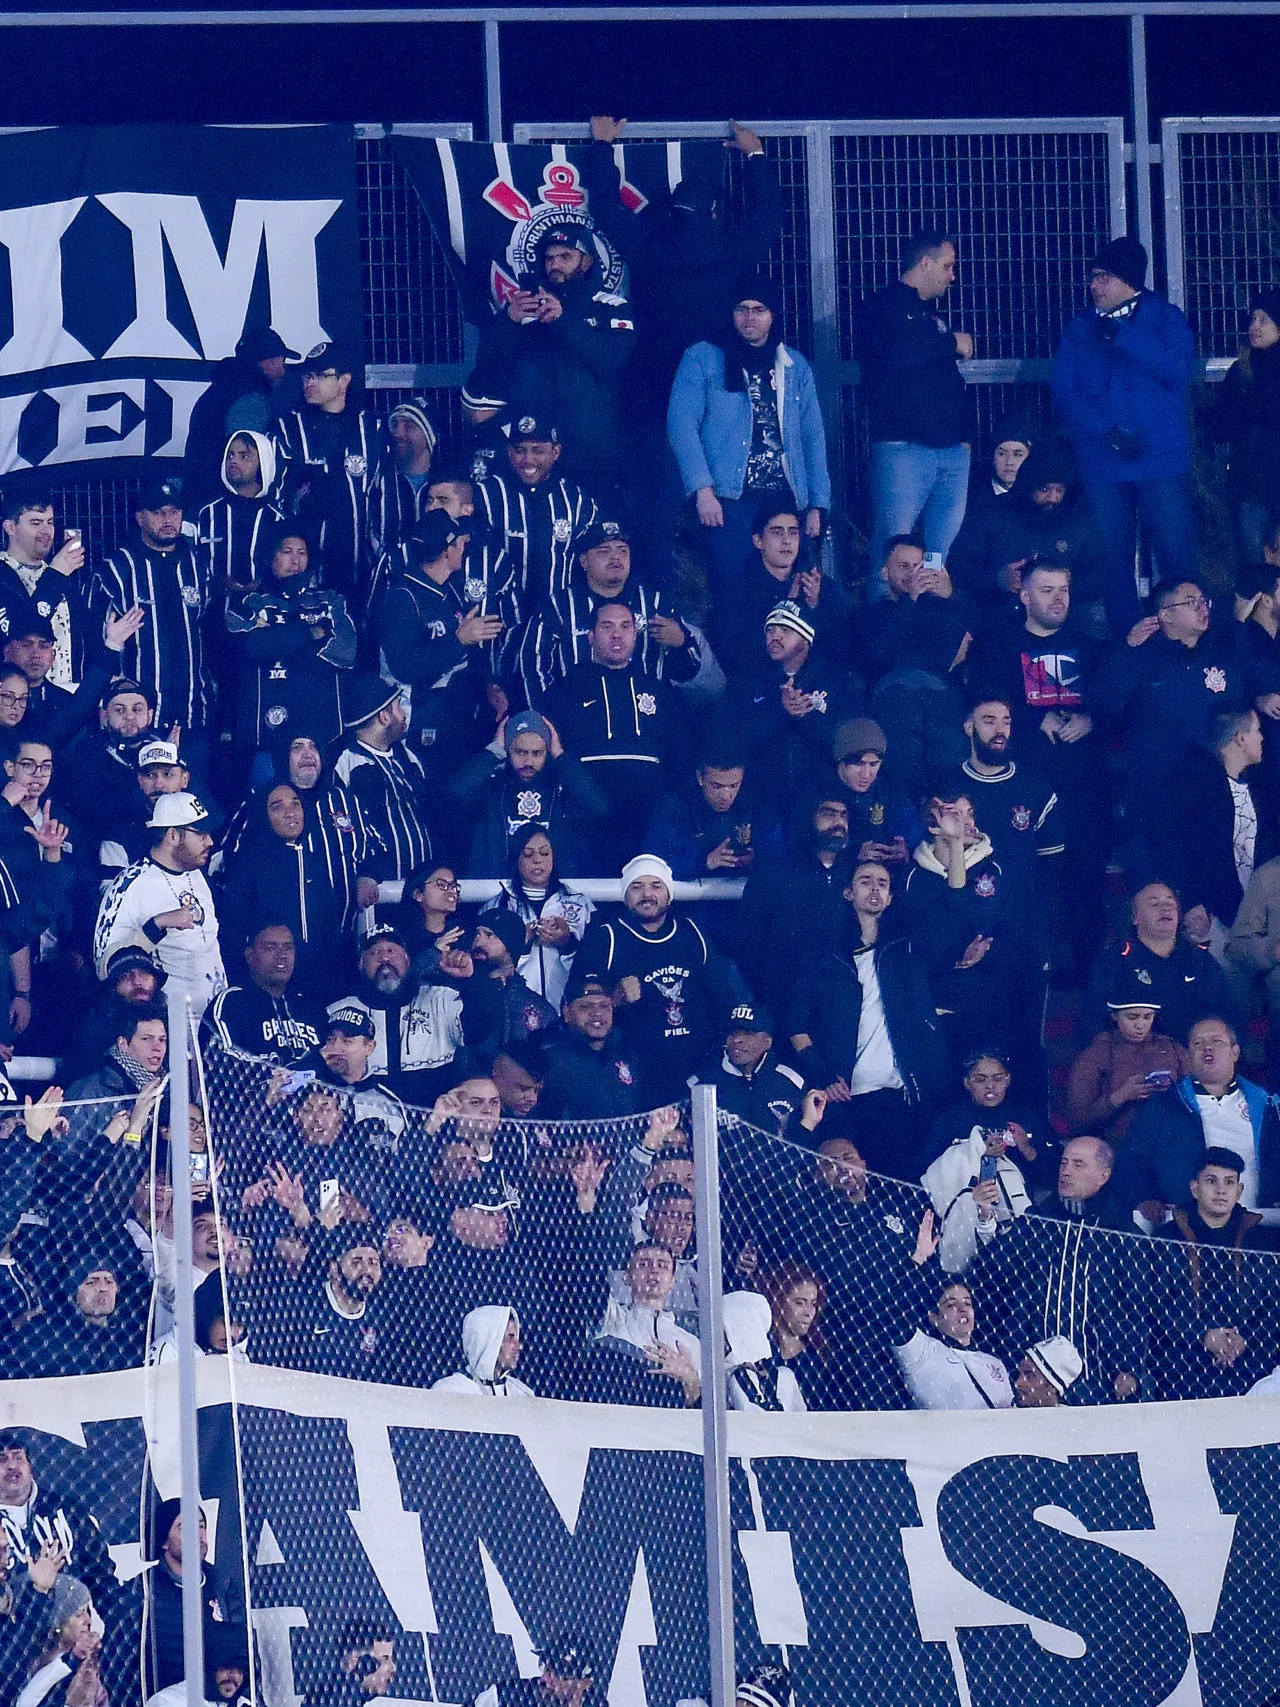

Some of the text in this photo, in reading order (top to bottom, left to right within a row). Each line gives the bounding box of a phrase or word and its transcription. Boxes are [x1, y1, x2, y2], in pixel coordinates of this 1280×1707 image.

[525, 214, 594, 263] CORINTHIANS
[644, 965, 690, 983] GAVIÕES
[662, 976, 675, 984] DA
[664, 1027, 690, 1038] FIEL
